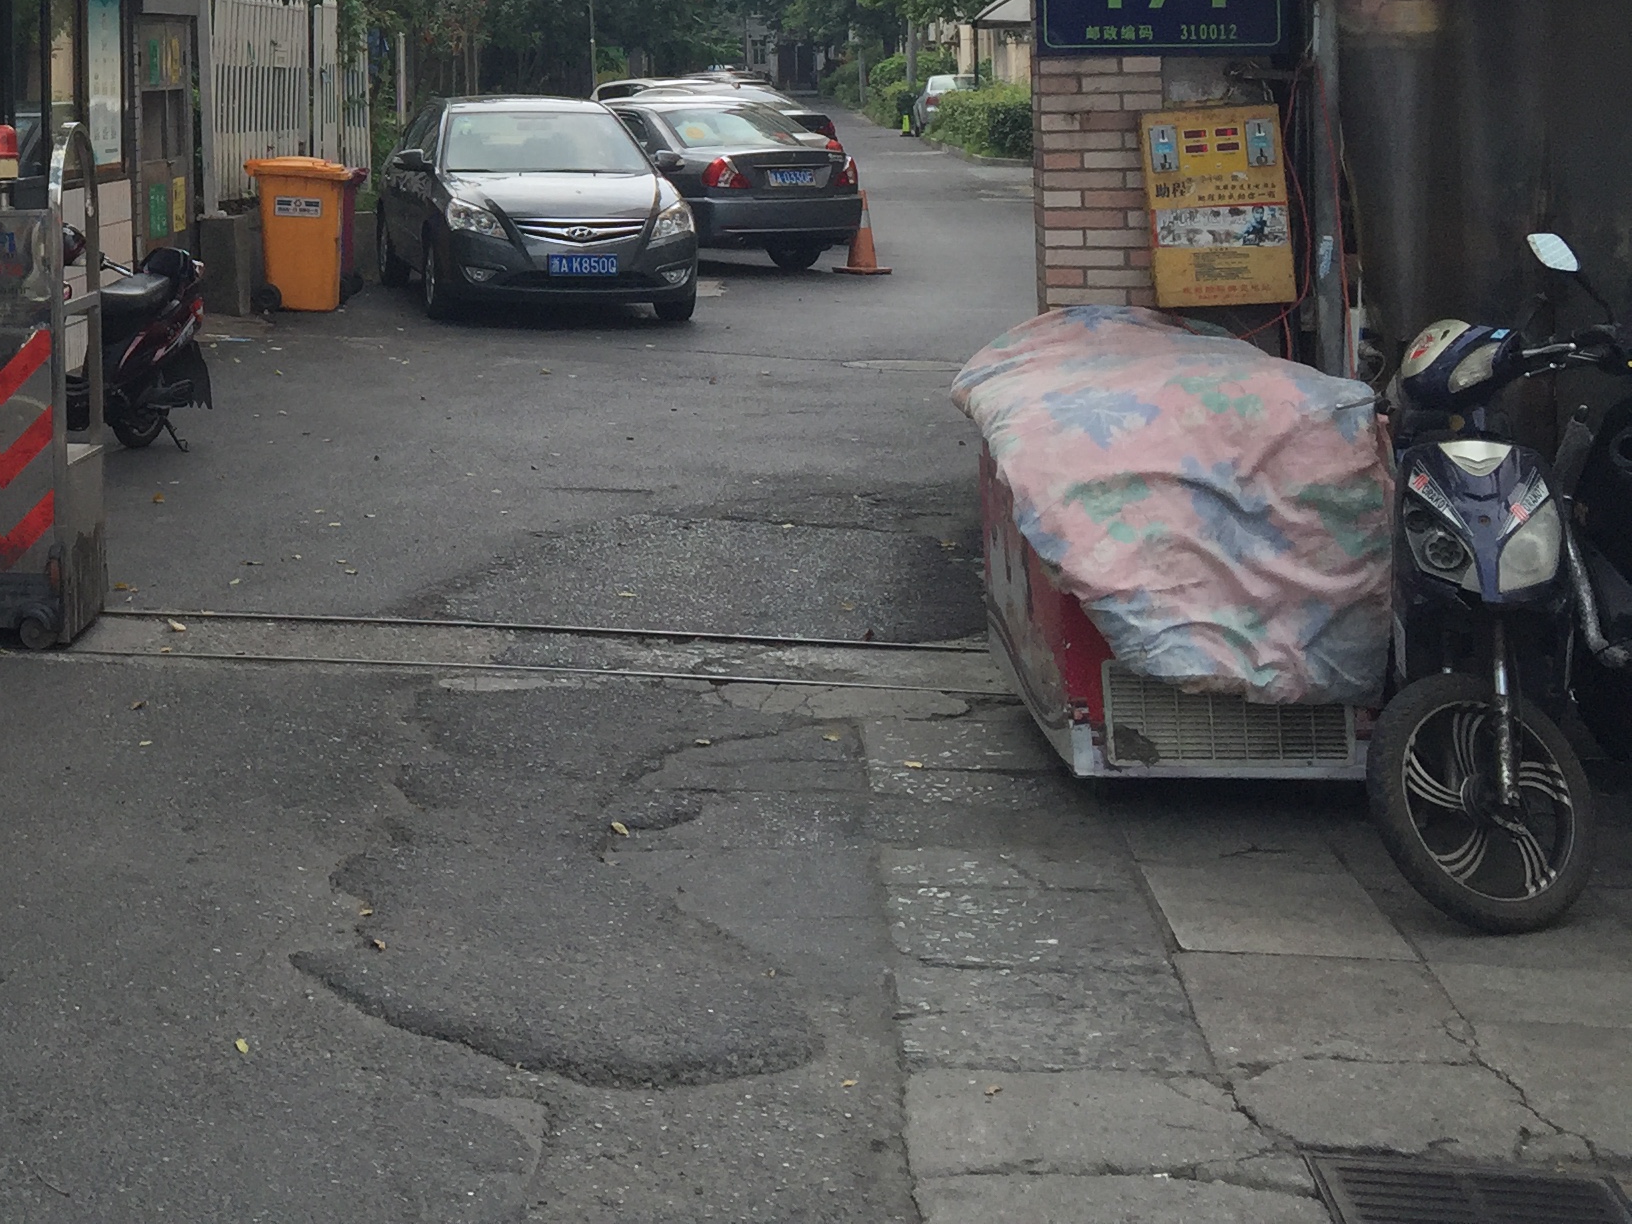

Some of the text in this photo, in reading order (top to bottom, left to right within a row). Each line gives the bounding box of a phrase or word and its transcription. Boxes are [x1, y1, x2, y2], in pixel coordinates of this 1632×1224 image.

[1085, 24, 1237, 41] 邮政编码 310012
